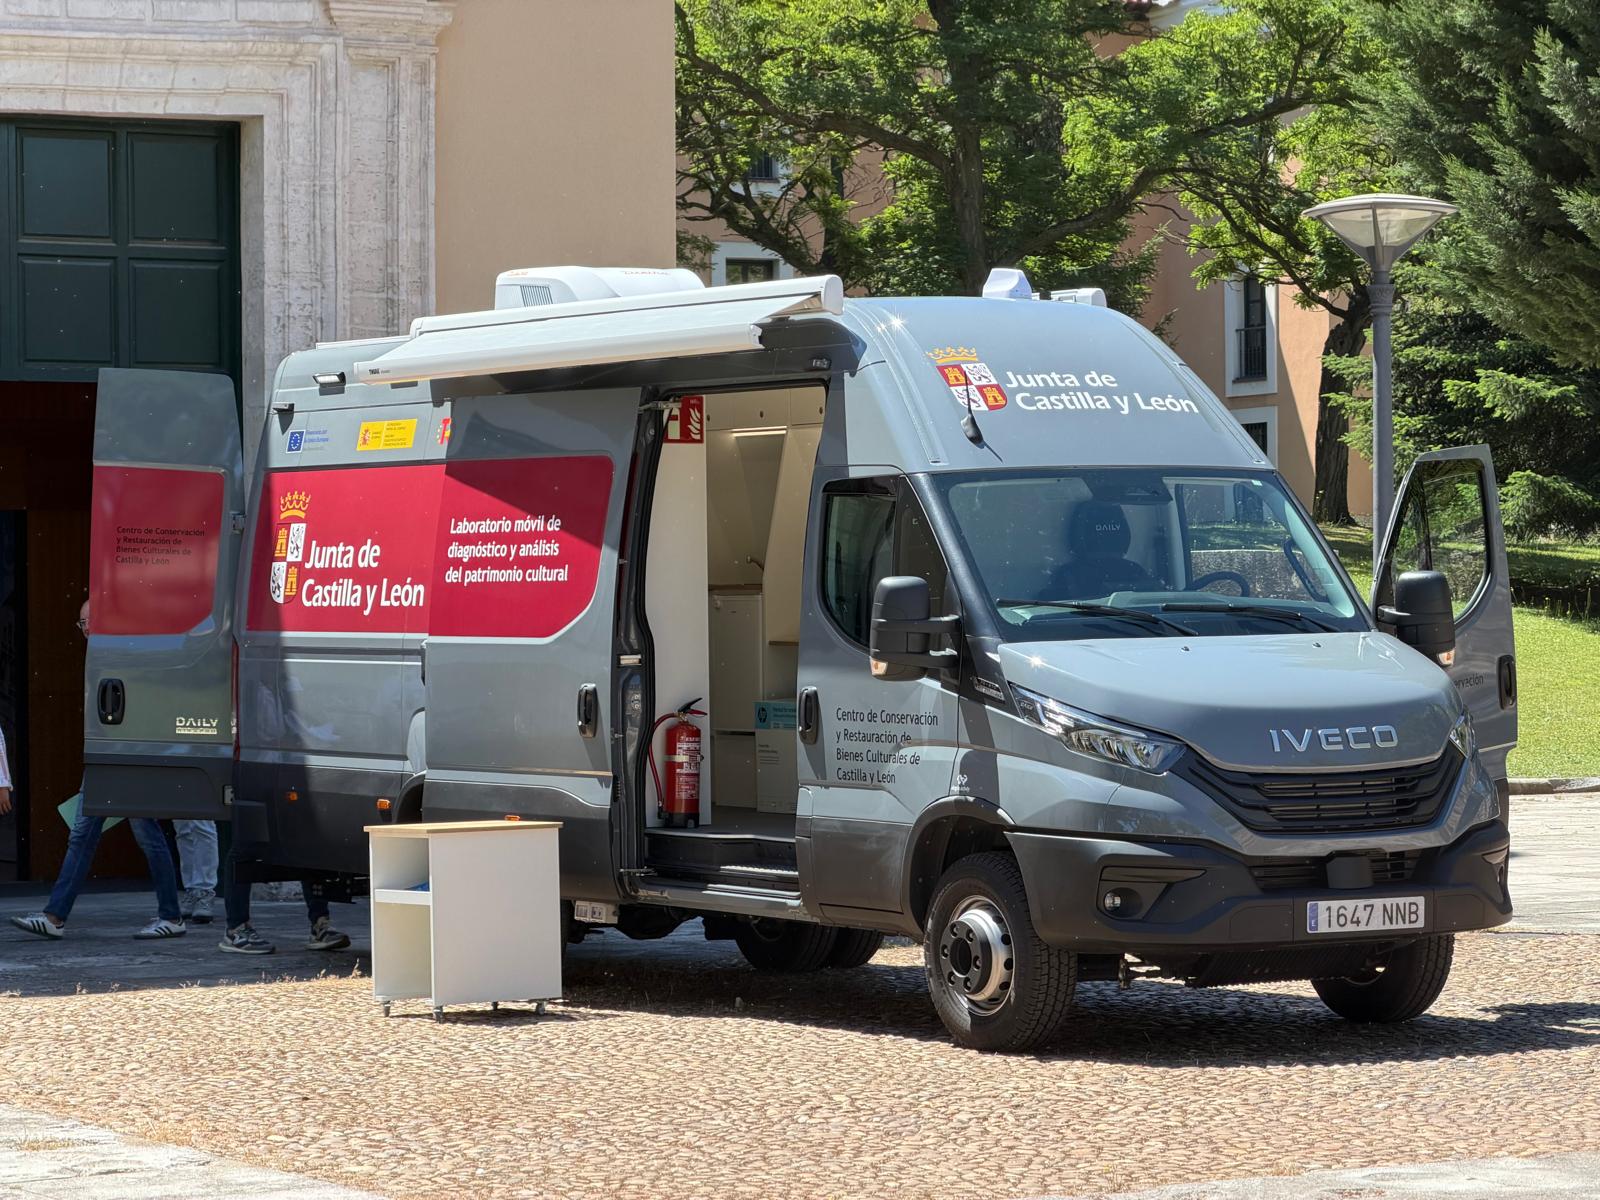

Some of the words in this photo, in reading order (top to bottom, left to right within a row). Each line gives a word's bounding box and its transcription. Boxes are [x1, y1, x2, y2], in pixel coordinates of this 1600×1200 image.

[1006, 371, 1080, 388] Junta
[1085, 371, 1118, 388] de
[1015, 392, 1110, 411] Castilla
[1112, 395, 1129, 415] y
[1132, 393, 1199, 414] León
[116, 526, 141, 534] Centro
[155, 527, 205, 536] Conservación
[450, 517, 511, 534] Laboratorio
[514, 515, 544, 532] móvil
[547, 515, 561, 531] de
[123, 536, 170, 545] Restauración
[116, 546, 141, 554] Bienes
[142, 546, 180, 555] Culturales
[305, 540, 354, 569] Junta
[359, 539, 381, 568] de
[447, 541, 508, 563] diagnóstico
[509, 544, 517, 561] y
[519, 540, 560, 556] análisis
[115, 556, 143, 564] Castilla
[445, 566, 462, 583] del
[464, 567, 523, 586] patrimonio
[525, 565, 569, 582] cultural
[301, 579, 361, 607] Castilla
[363, 584, 377, 615] y
[380, 577, 425, 607] León
[176, 717, 218, 726] DAILY
[836, 707, 865, 723] Centro
[867, 709, 878, 723] de
[880, 709, 938, 726] Conservación
[836, 731, 841, 744] y
[844, 728, 898, 744] Restauración
[900, 732, 912, 744] de
[1269, 725, 1399, 752] IVECO
[836, 747, 864, 762] Bienes
[866, 749, 907, 765] Culturales
[909, 752, 921, 765] de
[836, 767, 867, 783] Castilla
[870, 773, 874, 785] y
[877, 770, 896, 784] León
[1326, 904, 1374, 928] 1647
[1382, 902, 1419, 926] NNB
